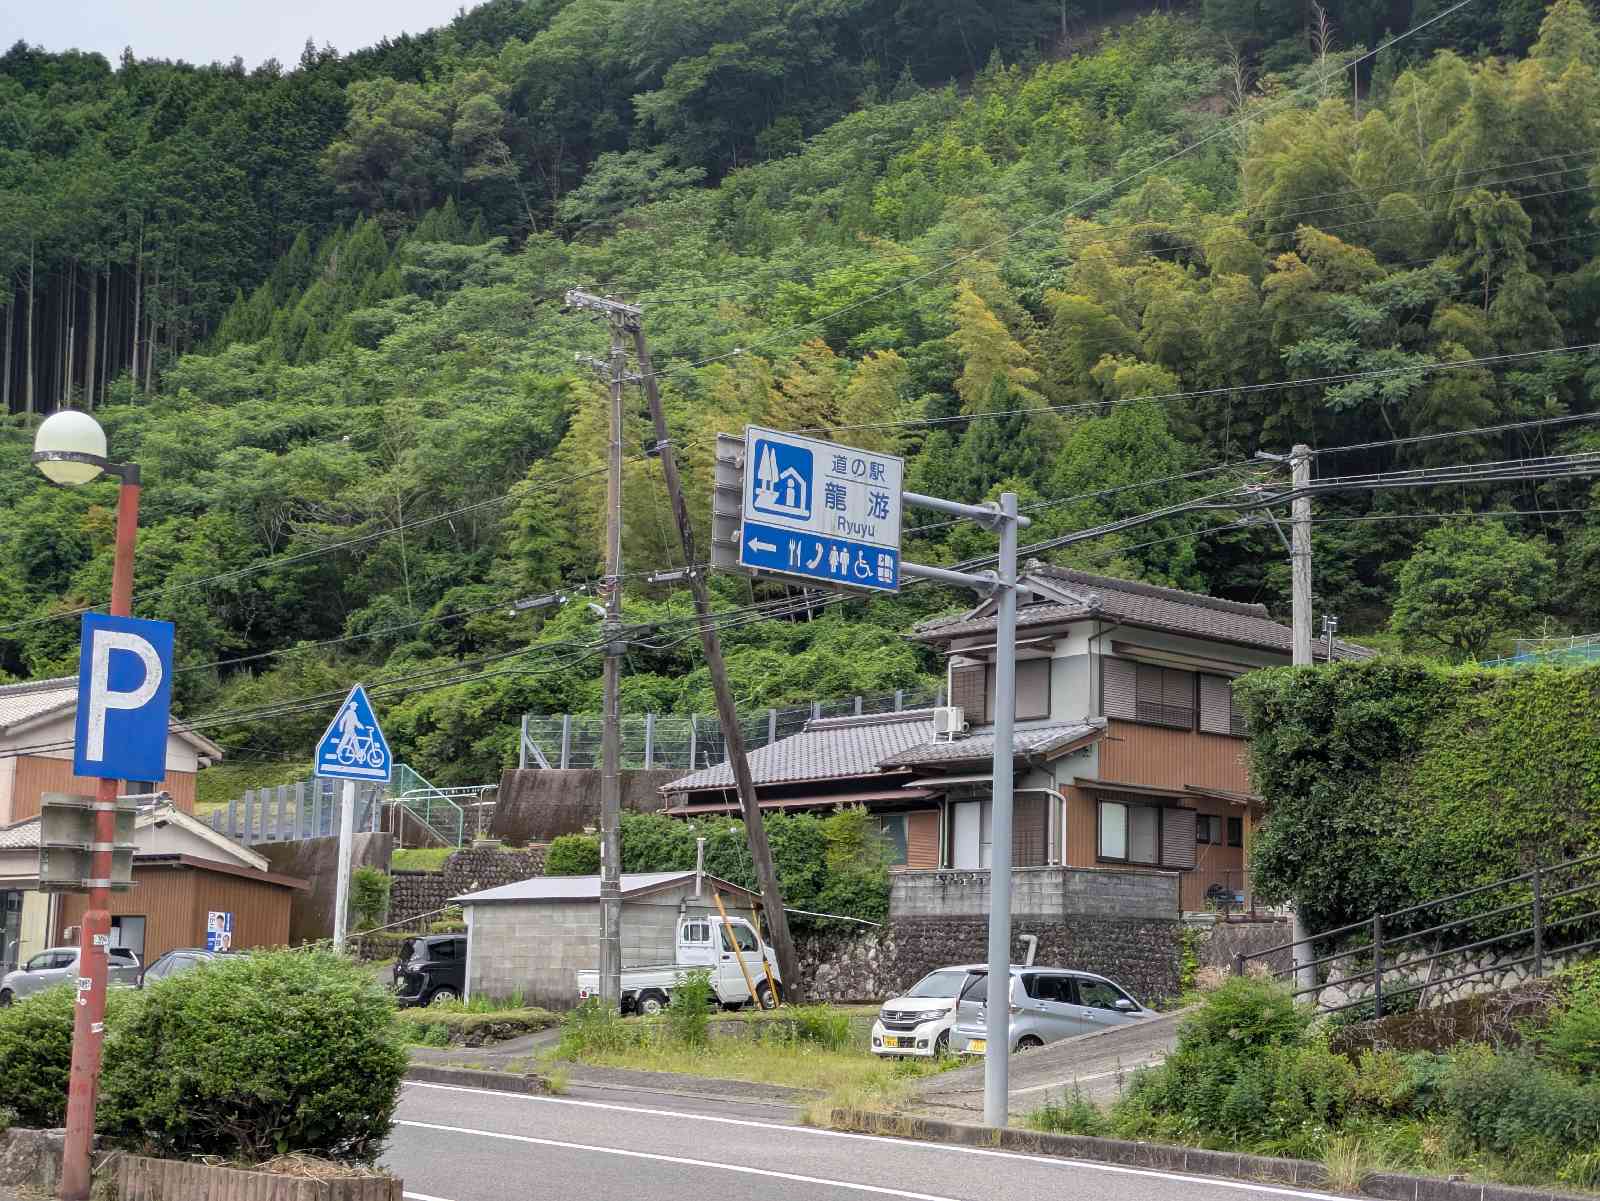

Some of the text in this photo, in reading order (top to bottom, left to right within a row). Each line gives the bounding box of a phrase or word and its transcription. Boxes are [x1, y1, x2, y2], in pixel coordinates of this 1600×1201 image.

[832, 455, 885, 481] 道の駅
[825, 482, 890, 519] 龍游
[837, 516, 875, 538] Ryuyu
[86, 629, 163, 761] P
